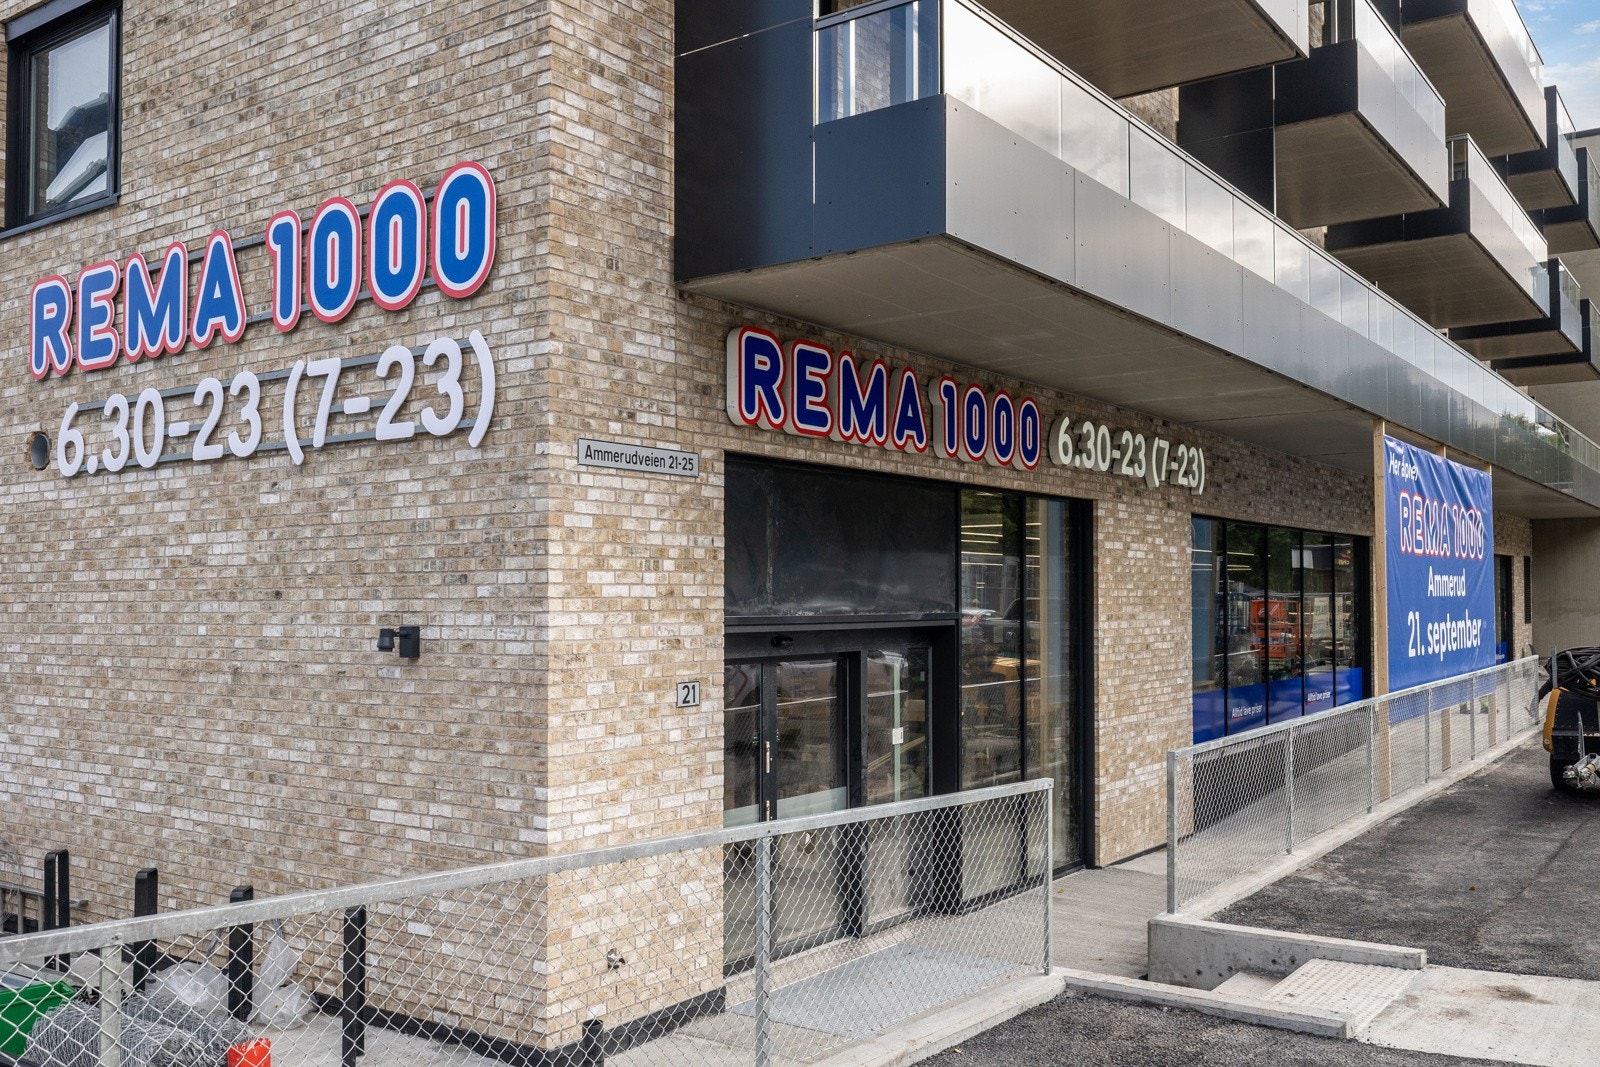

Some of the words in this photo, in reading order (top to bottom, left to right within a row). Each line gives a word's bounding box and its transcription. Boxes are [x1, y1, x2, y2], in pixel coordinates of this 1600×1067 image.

[30, 229, 247, 380] REMA
[267, 161, 496, 332] 1000
[57, 371, 262, 477] 6.30-23
[283, 330, 496, 466] (7-23)
[735, 325, 929, 453] REMA
[938, 375, 1041, 470] 1000
[584, 444, 666, 469] Ammerudveien
[668, 455, 694, 471] 21-25
[1057, 416, 1146, 477] 6.30-23
[1152, 437, 1205, 495] (7-23)
[1399, 490, 1450, 559] REMA
[1452, 503, 1485, 561] 1000
[1428, 565, 1466, 597] Ammerud
[1407, 610, 1425, 657] 21.
[1427, 608, 1482, 662] september
[682, 684, 696, 704] 21
